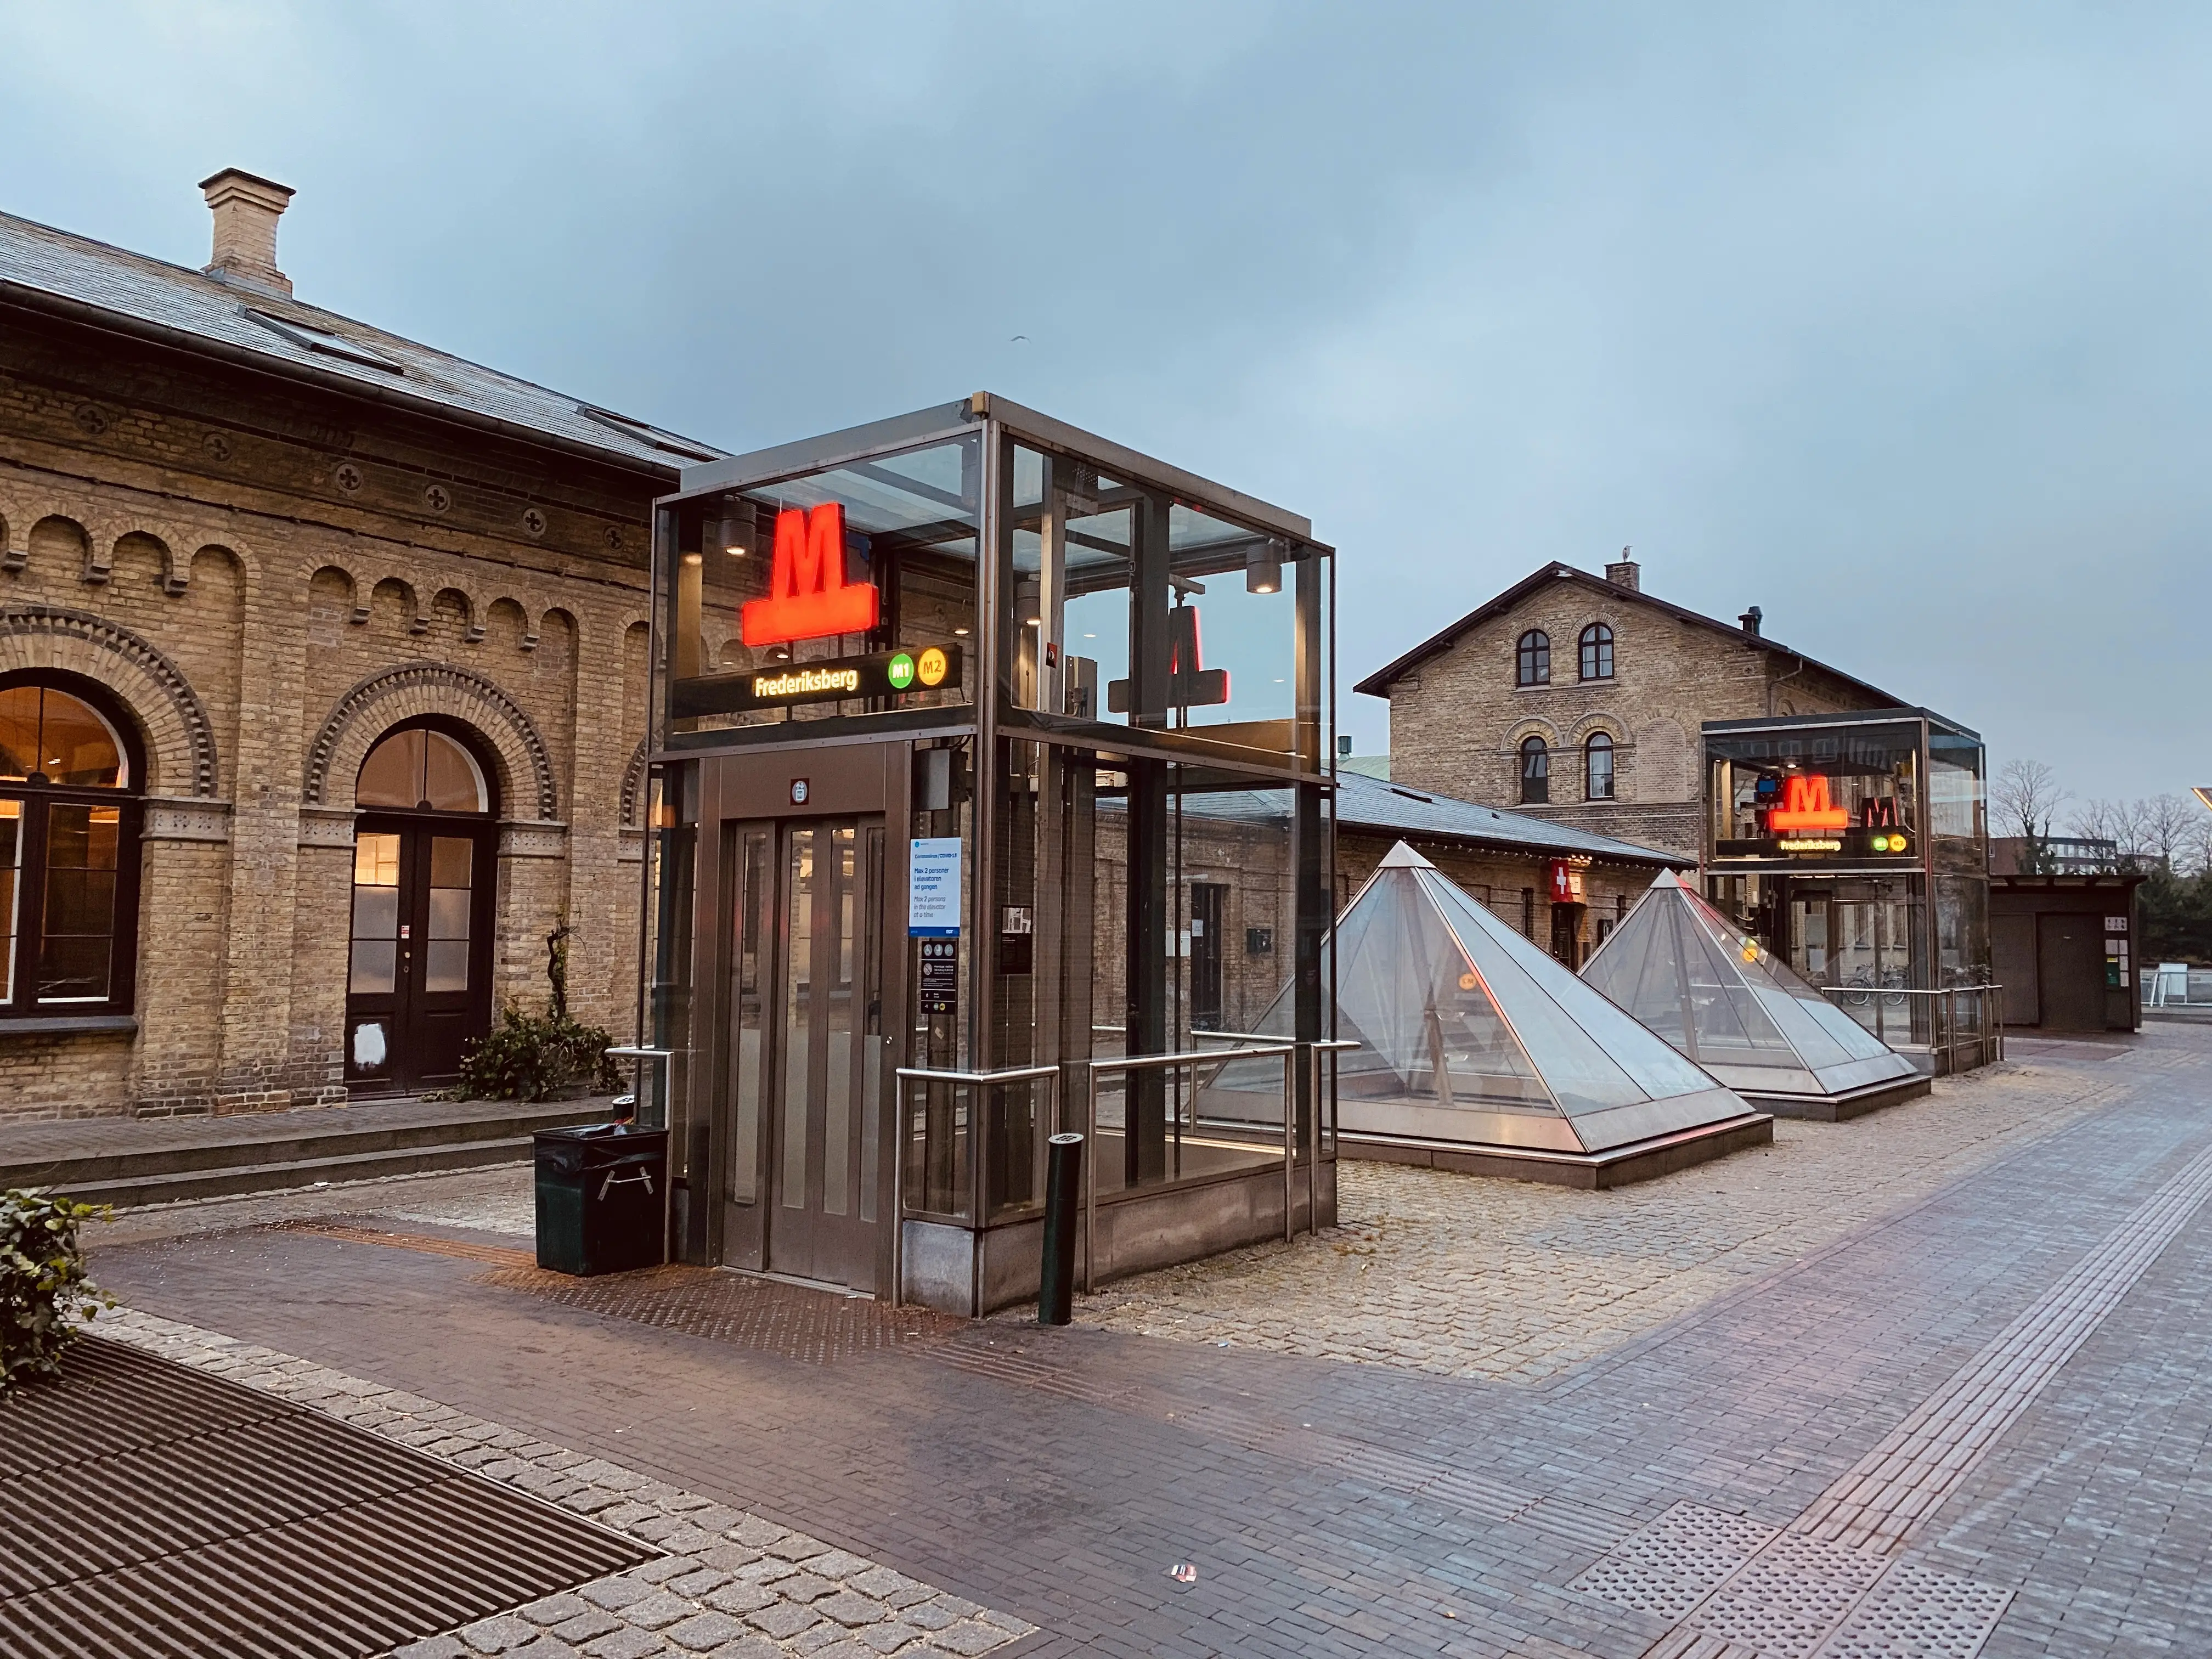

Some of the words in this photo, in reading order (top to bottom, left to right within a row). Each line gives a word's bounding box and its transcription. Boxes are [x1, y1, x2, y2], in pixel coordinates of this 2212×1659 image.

[755, 669, 857, 697] Frederiksberg
[892, 663, 909, 679] M1
[923, 659, 942, 674] M2
[1780, 839, 1841, 851] Frederiksberg
